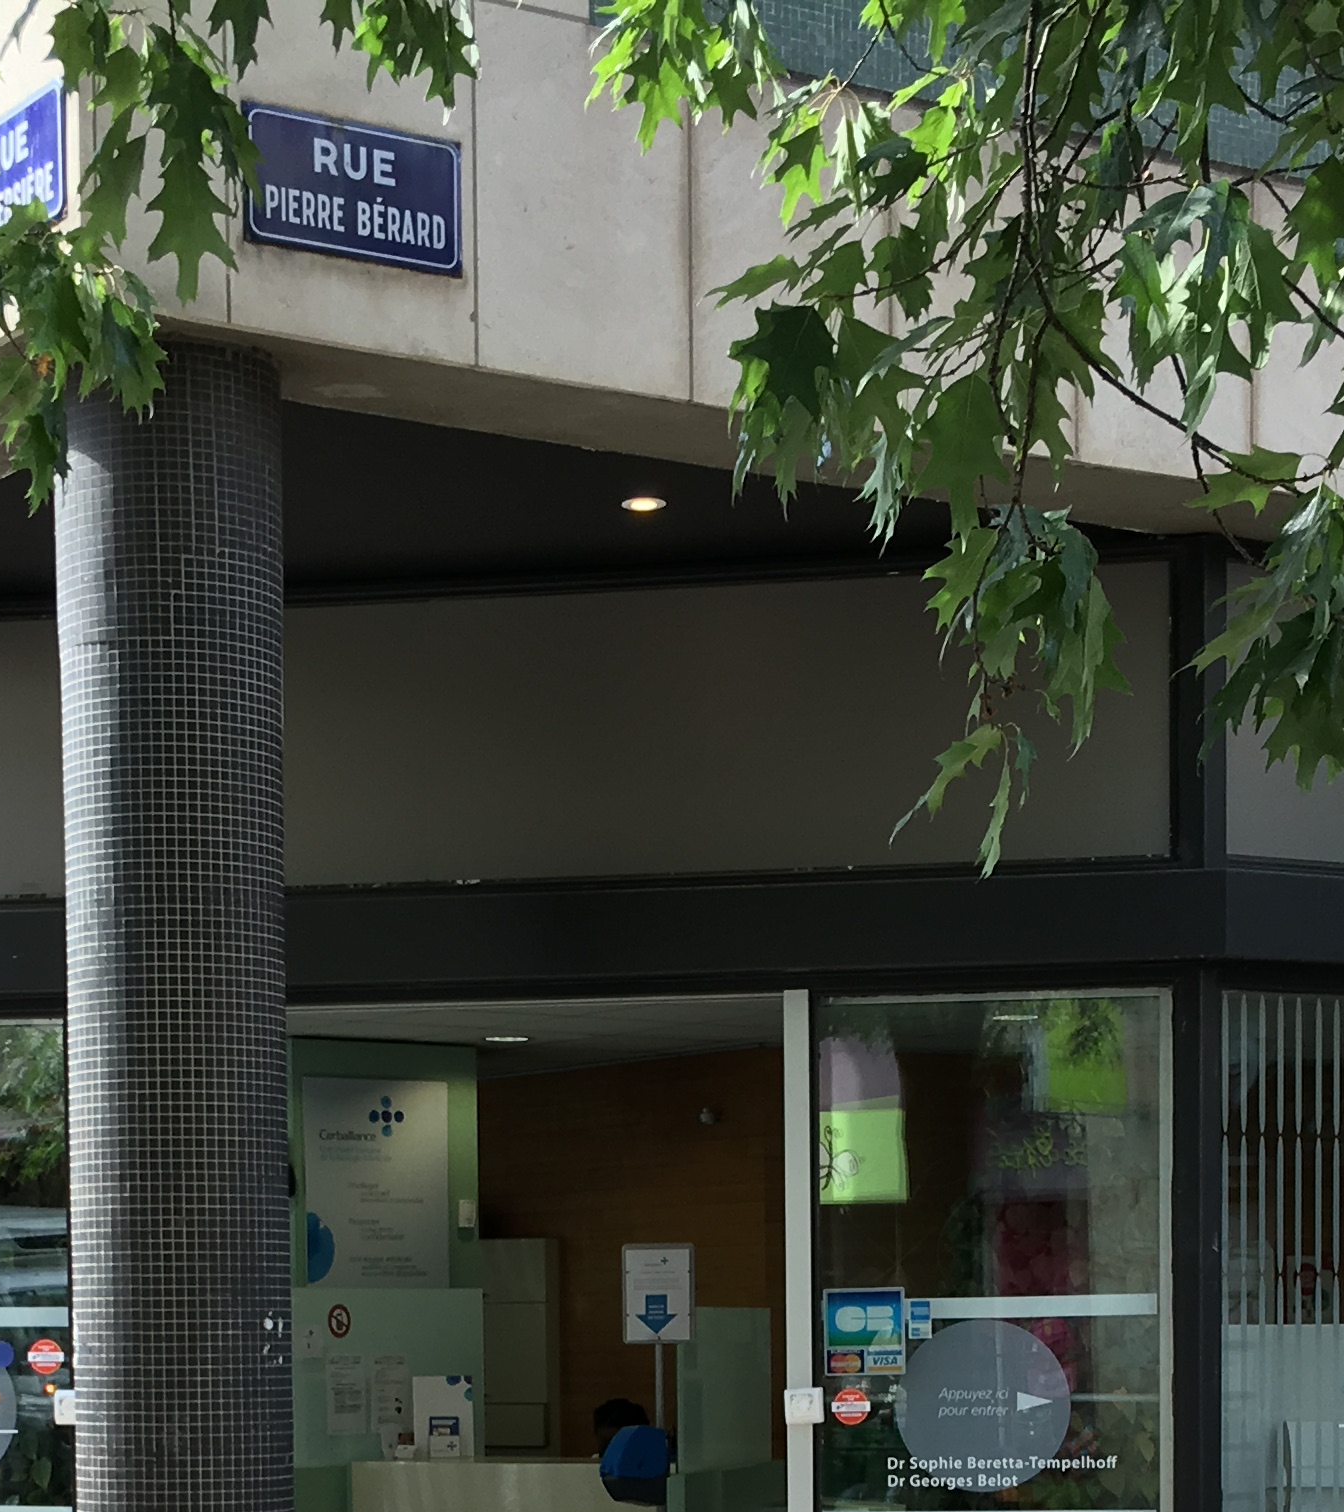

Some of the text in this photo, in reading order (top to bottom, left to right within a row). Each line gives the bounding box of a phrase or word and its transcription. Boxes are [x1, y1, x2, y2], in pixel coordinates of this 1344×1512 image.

[312, 137, 396, 187] RUE
[265, 184, 447, 251] PIERRE BÉRARD
[873, 1357, 898, 1366] VISA
[939, 1387, 1009, 1402] Appuyez ici
[938, 1404, 1009, 1418] pour entrer
[887, 1454, 1119, 1473] Dr Sophie Beretta-Tempelhoff
[887, 1472, 1019, 1491] Dr Georges Belot
